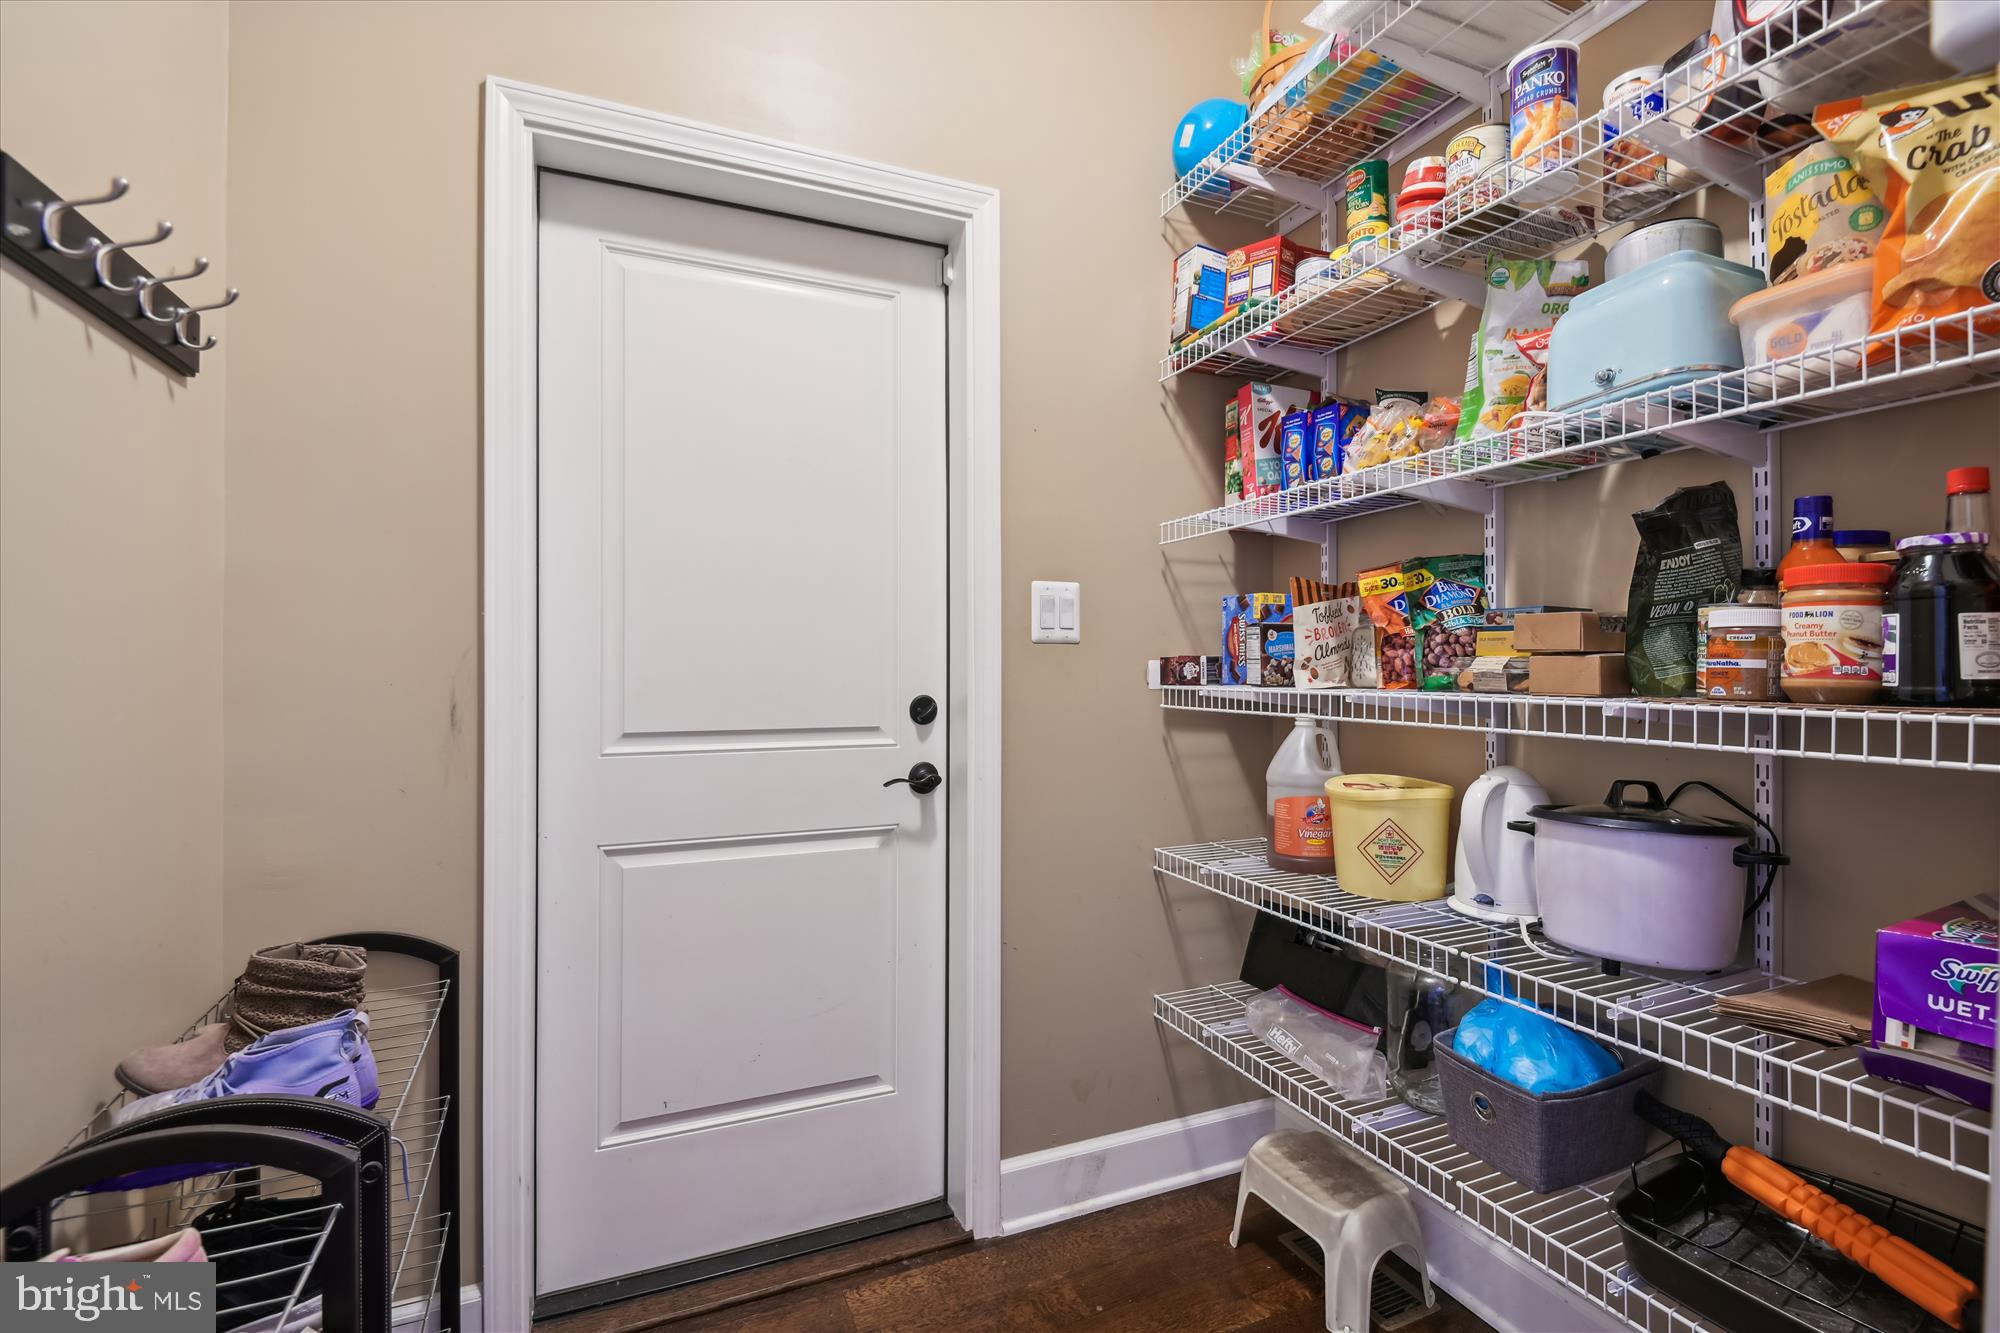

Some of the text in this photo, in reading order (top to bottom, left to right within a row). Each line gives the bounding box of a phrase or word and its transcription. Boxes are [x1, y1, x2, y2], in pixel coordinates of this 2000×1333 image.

[1514, 71, 1566, 100] PANKO
[1536, 86, 1562, 98] CRUMBS
[1906, 124, 1991, 171] Crab
[1660, 553, 1691, 570] ENJOY
[1364, 585, 1380, 593] SIZE
[1380, 576, 1398, 589] 30
[1436, 580, 1462, 594] BLUE
[1424, 587, 1477, 607] DIAMOND
[1442, 605, 1475, 621] BOLD
[1649, 602, 1680, 619] VEGAN
[1789, 610, 1834, 619] FOOD LION
[1238, 613, 1246, 639] SWISS
[1313, 621, 1347, 641] BROKEN
[1794, 622, 1824, 630] Creamy
[1298, 828, 1334, 840] Vinegar
[1269, 1025, 1297, 1054] Hefty
